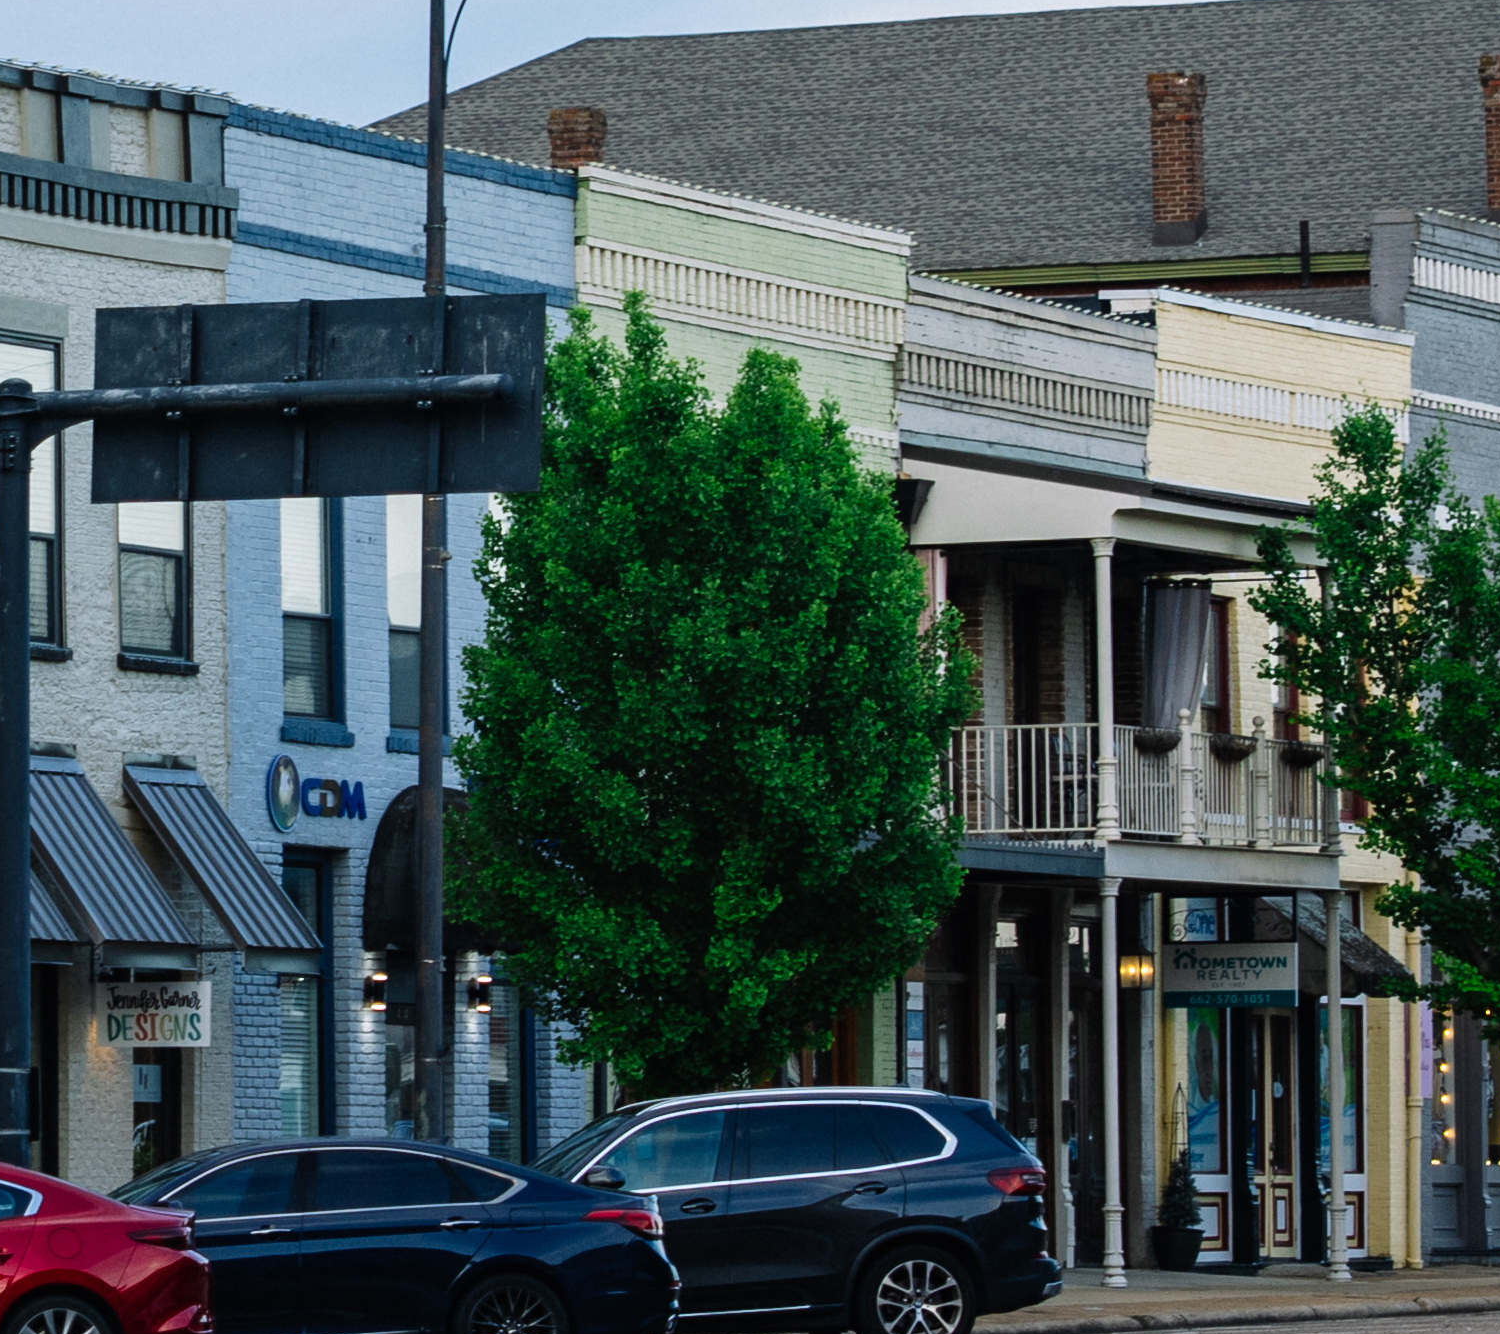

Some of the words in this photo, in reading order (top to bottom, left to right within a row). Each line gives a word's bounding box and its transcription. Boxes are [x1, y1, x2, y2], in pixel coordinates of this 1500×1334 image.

[301, 778, 367, 820] CDM
[1197, 969, 1263, 981] REALTY
[107, 986, 161, 1014] Jennifer
[160, 986, 202, 1011] Garner
[1189, 993, 1271, 1005] 662-570-1051
[107, 1013, 202, 1043] DESIGNS
